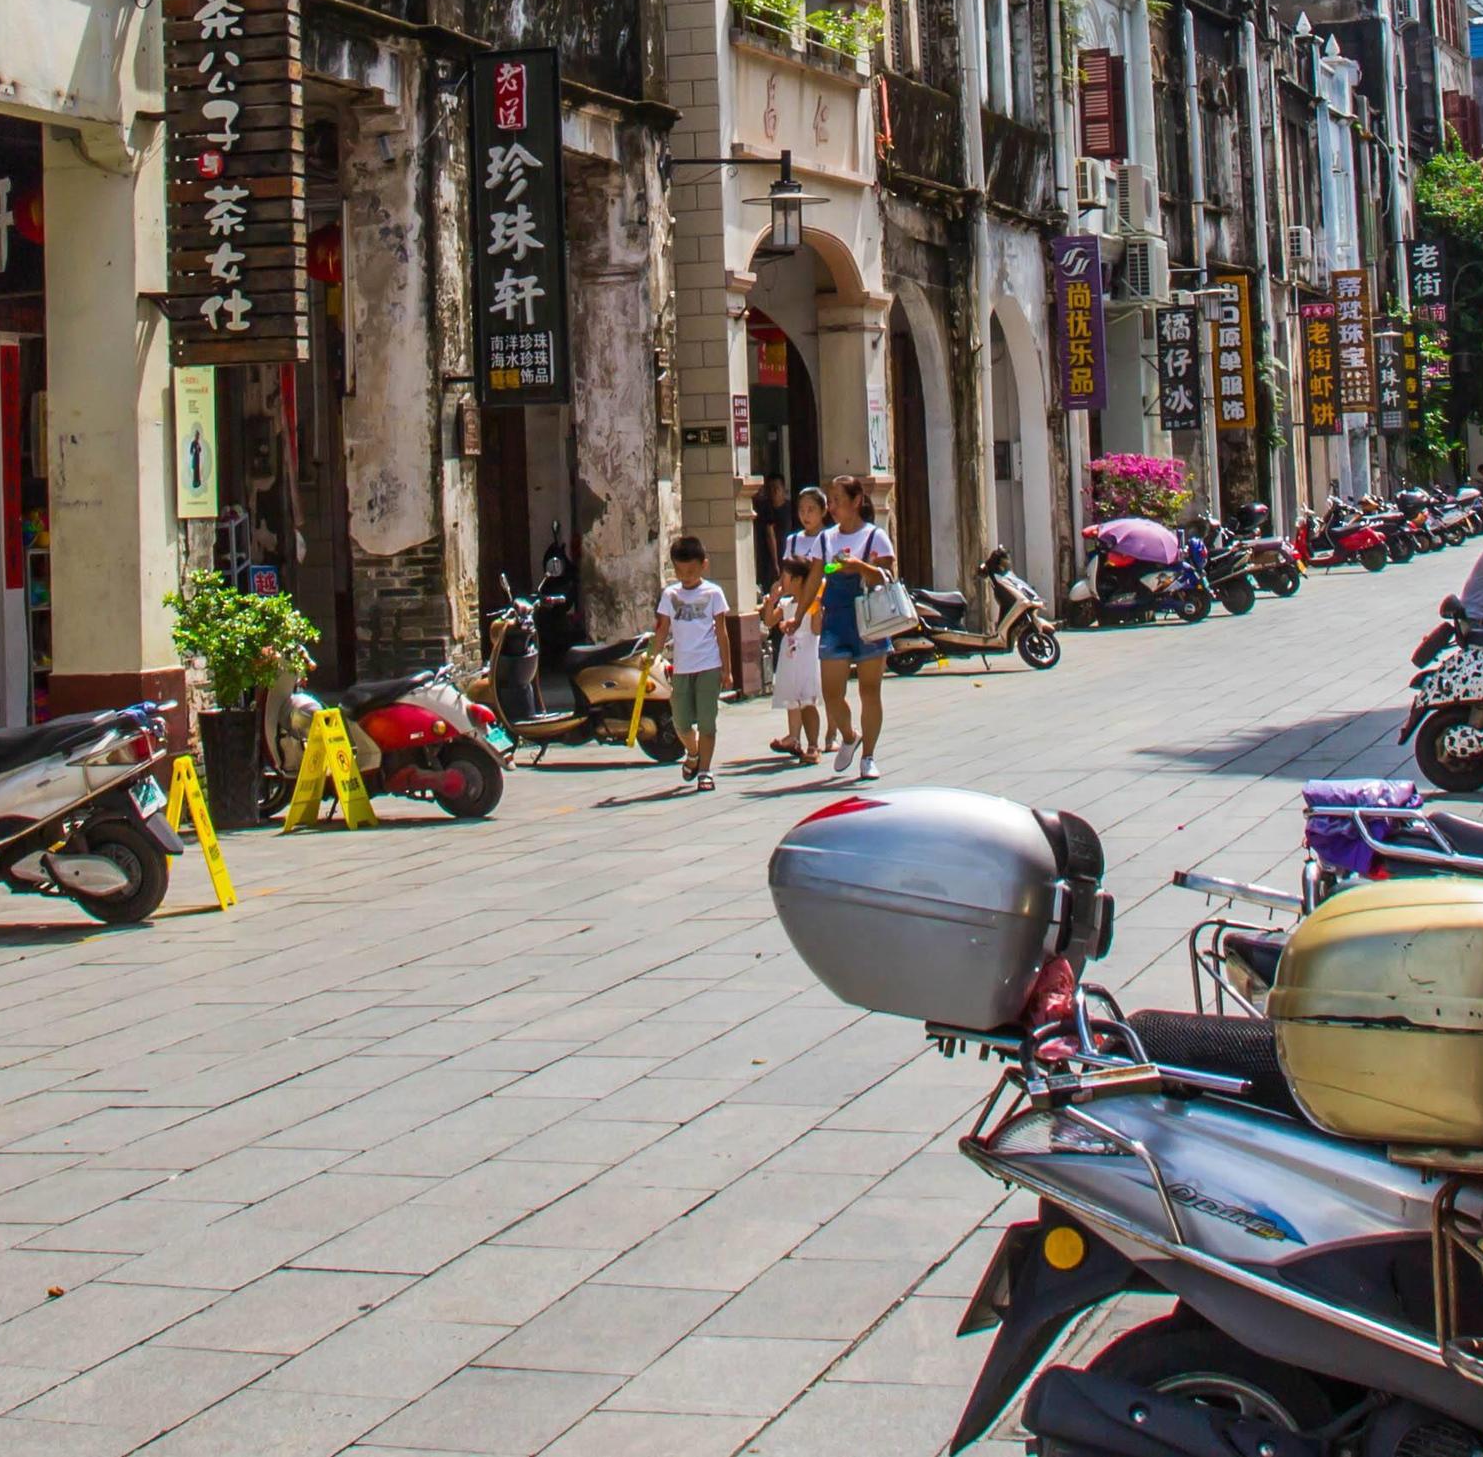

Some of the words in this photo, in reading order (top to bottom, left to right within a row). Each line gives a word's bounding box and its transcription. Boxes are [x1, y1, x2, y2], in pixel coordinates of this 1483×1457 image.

[484, 142, 546, 326] 珍珠轩
[1413, 243, 1442, 297] 老街
[490, 332, 549, 352] 南洋珍珠
[491, 350, 549, 369] 海水珍珠
[1065, 281, 1094, 394] 尚优乐品
[1160, 313, 1194, 413] 橘仔冰
[1219, 283, 1245, 420] 出口原单服饰
[1308, 321, 1335, 426] 老街虾饼
